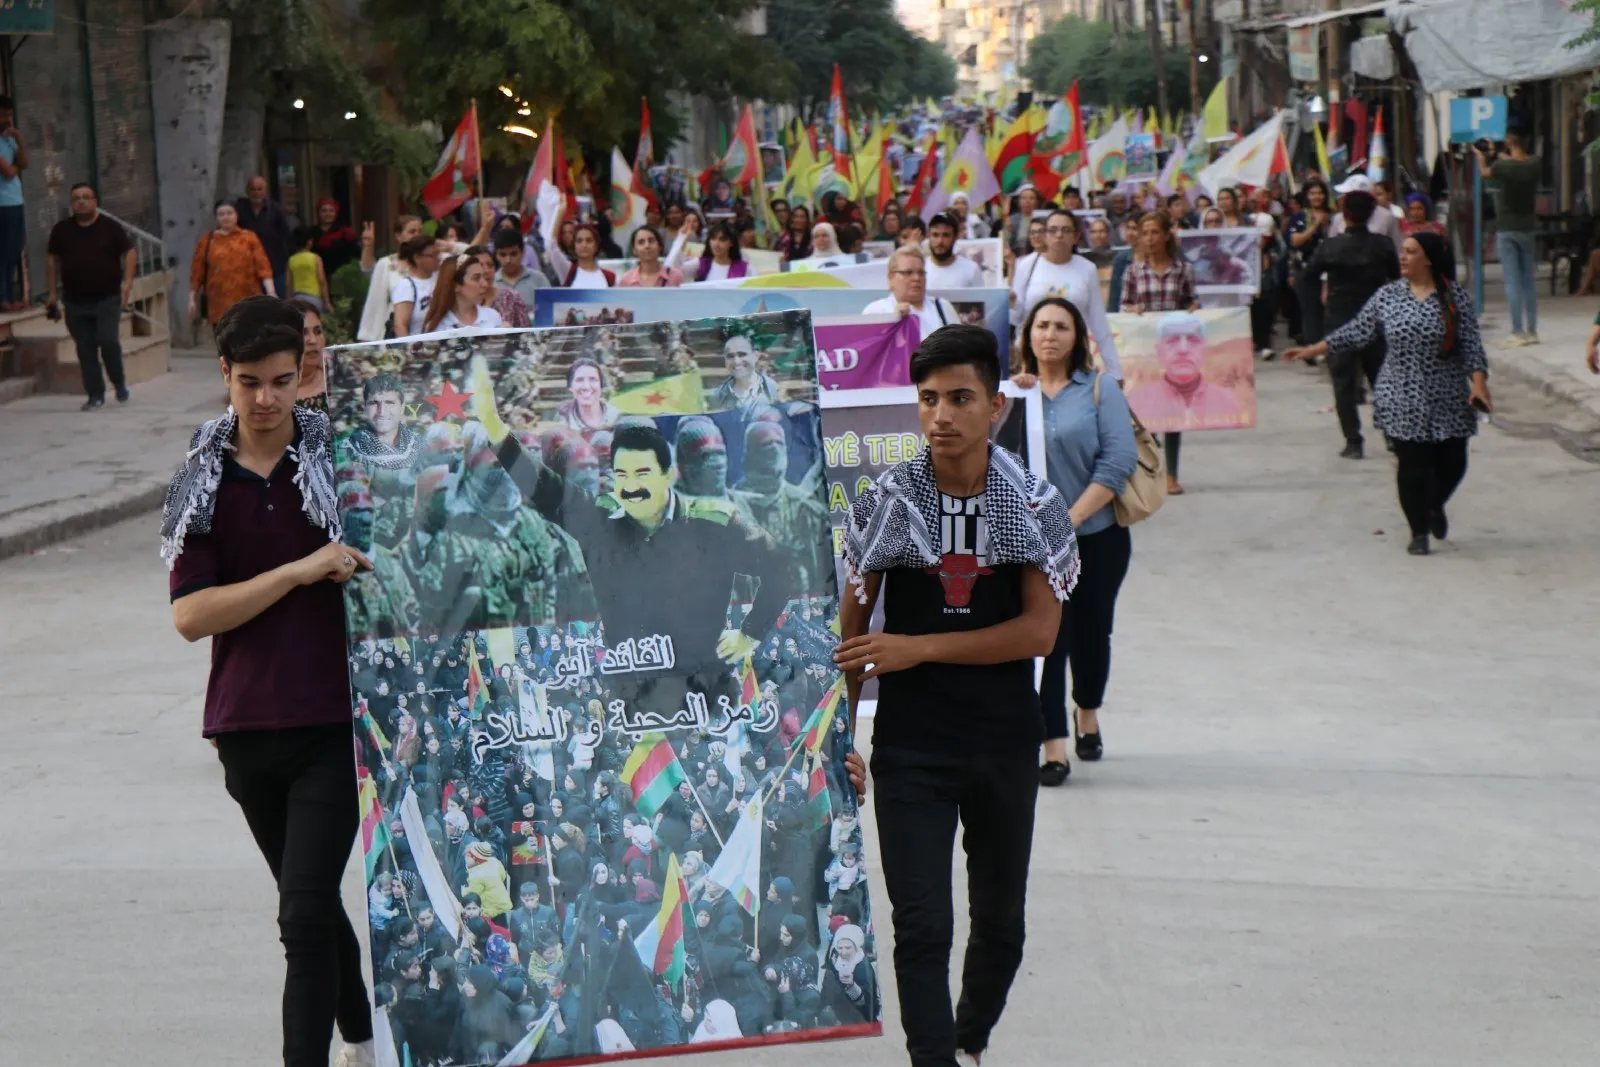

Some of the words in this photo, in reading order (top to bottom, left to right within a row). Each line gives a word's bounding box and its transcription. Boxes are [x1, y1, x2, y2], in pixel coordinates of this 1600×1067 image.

[1471, 98, 1495, 130] P
[601, 634, 675, 675] القائد
[472, 706, 568, 765] السلام
[578, 718, 604, 749] و
[608, 692, 709, 742] المحبة
[708, 695, 779, 737] رمز
